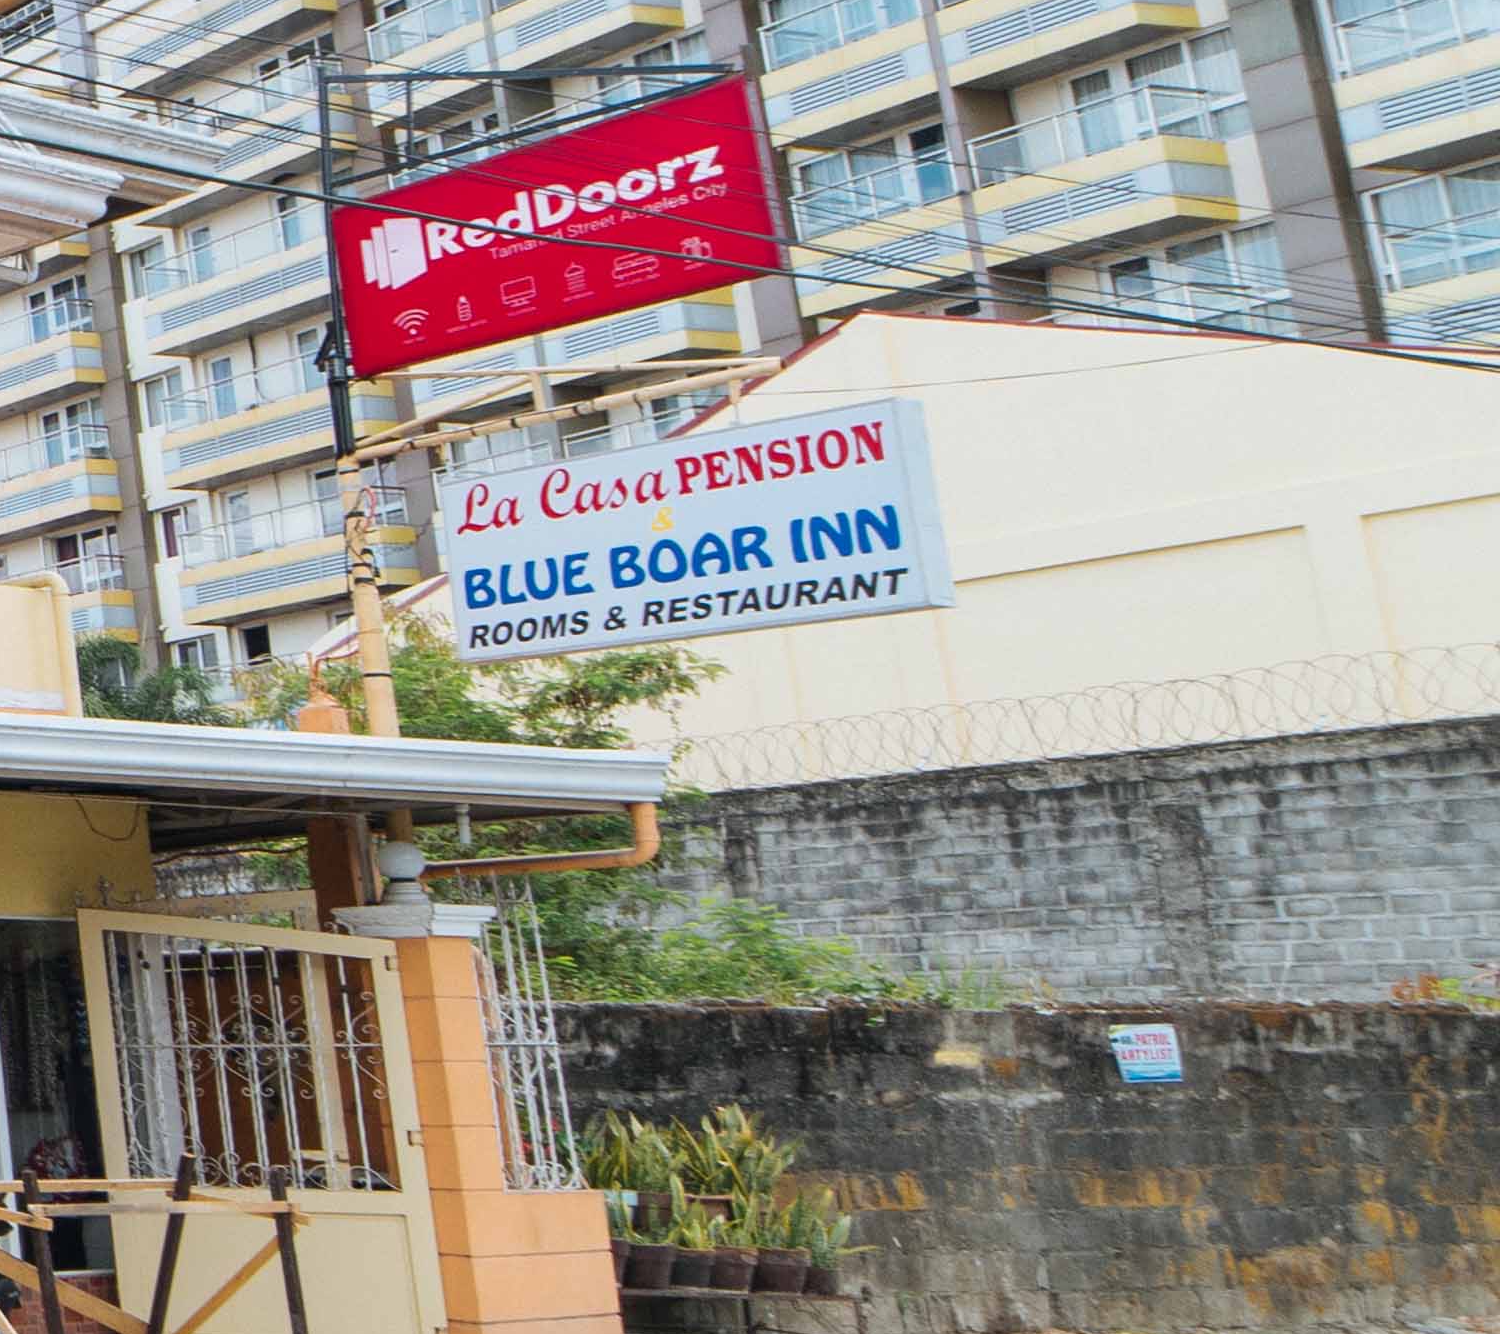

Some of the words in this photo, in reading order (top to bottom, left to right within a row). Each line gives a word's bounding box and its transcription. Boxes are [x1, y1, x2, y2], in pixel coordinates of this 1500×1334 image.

[424, 144, 725, 261] RedDoorz
[489, 228, 564, 259] Tamard
[566, 214, 616, 239] Street
[692, 182, 727, 202] City
[457, 483, 524, 536] La
[540, 468, 670, 520] Casa
[675, 421, 885, 496] PENSION
[464, 551, 595, 610] BLUE
[609, 525, 773, 589] BOAR
[789, 504, 901, 564] INN
[469, 610, 590, 649] ROOMS
[604, 605, 626, 631] &
[642, 567, 909, 627] RESTAURANT
